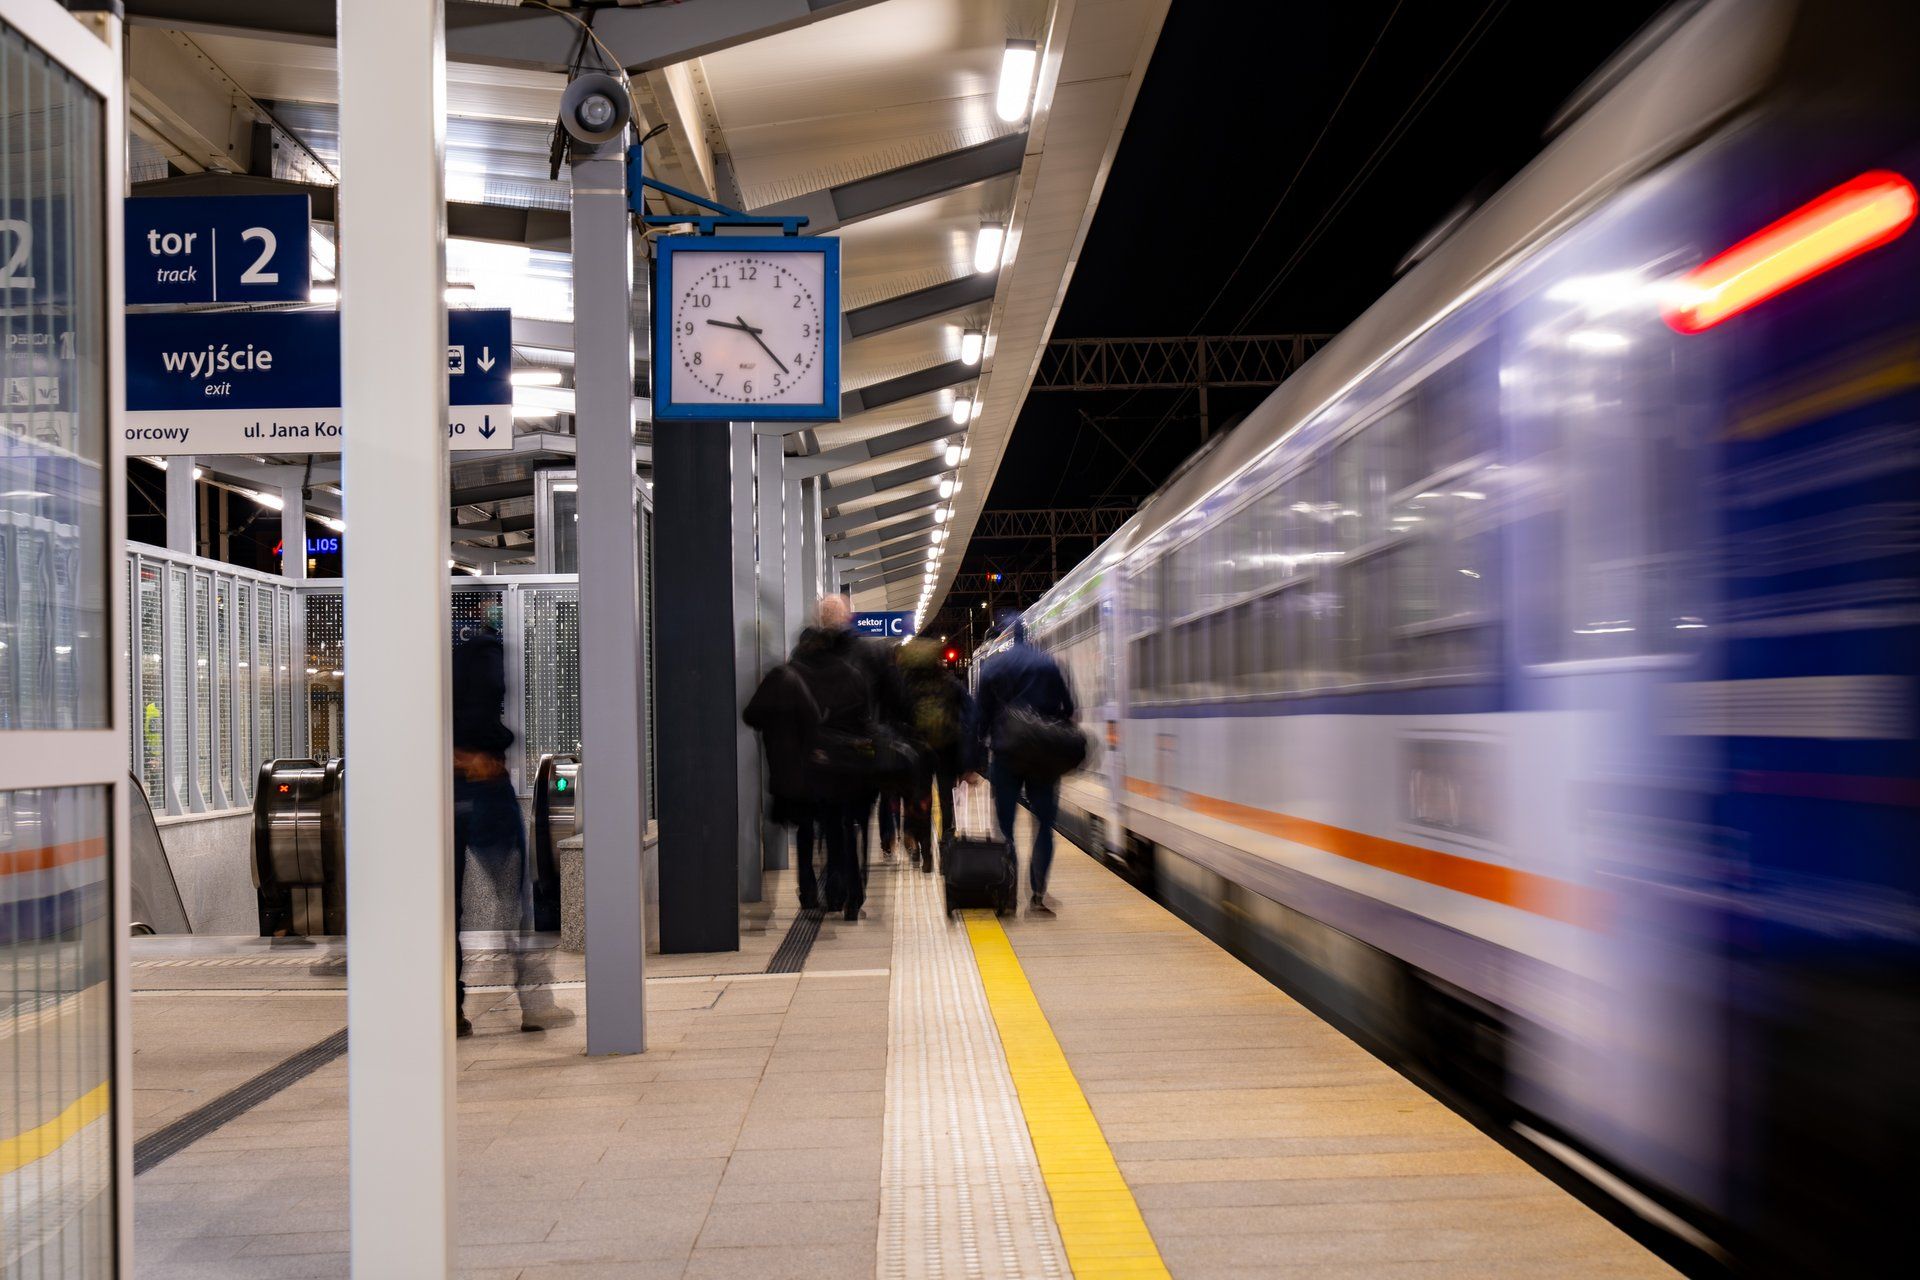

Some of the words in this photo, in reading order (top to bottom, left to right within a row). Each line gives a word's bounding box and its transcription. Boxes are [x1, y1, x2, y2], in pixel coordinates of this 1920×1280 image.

[0, 219, 35, 288] 2
[147, 229, 197, 255] tor
[240, 226, 279, 284] 2
[157, 266, 197, 282] track
[739, 267, 757, 280] 12
[712, 276, 731, 288] 11
[773, 276, 782, 288] 1
[692, 295, 711, 309] 10
[793, 295, 801, 309] 2
[685, 322, 694, 335] 9
[802, 324, 810, 337] 3
[162, 343, 273, 378] wyjście
[693, 352, 702, 366] 8
[793, 353, 802, 366] 4
[715, 373, 724, 386] 7
[773, 374, 781, 387] 5
[205, 381, 231, 395] exit
[743, 380, 752, 394] 6
[244, 422, 265, 438] ul.
[269, 422, 309, 438] Jana
[857, 618, 883, 626] sektor
[891, 618, 902, 633] C
